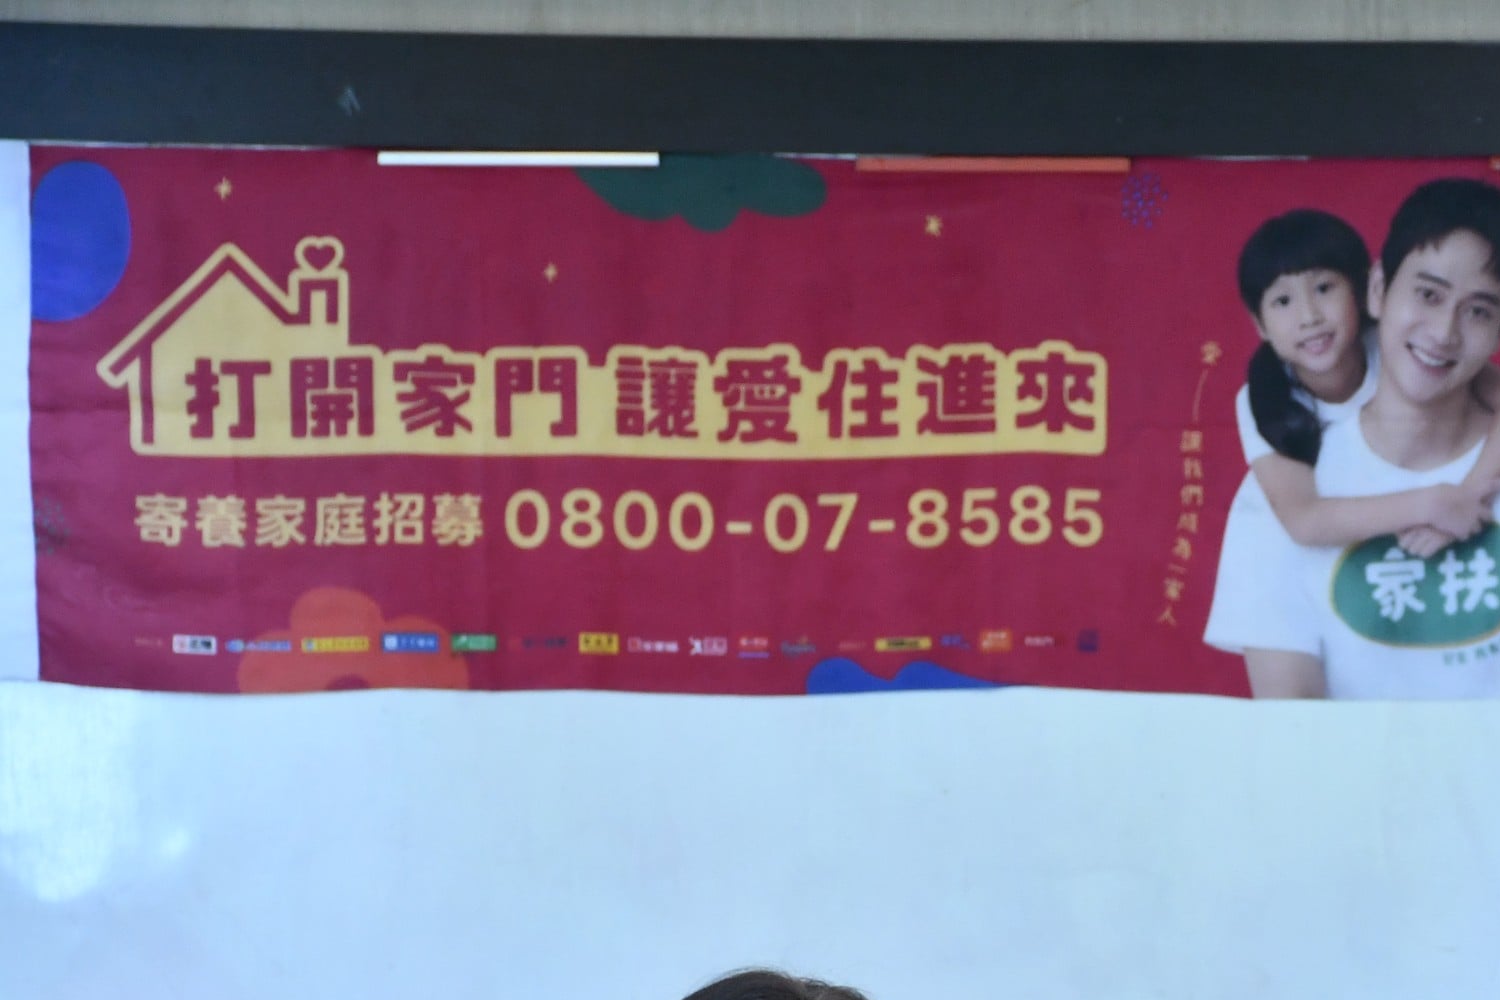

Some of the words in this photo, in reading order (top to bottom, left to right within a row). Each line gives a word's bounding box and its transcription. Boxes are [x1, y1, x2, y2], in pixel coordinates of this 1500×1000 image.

[135, 492, 484, 547] 寄養家庭招募
[505, 486, 1103, 552] 0800-07-8585
[1366, 548, 1500, 621] 家扶
